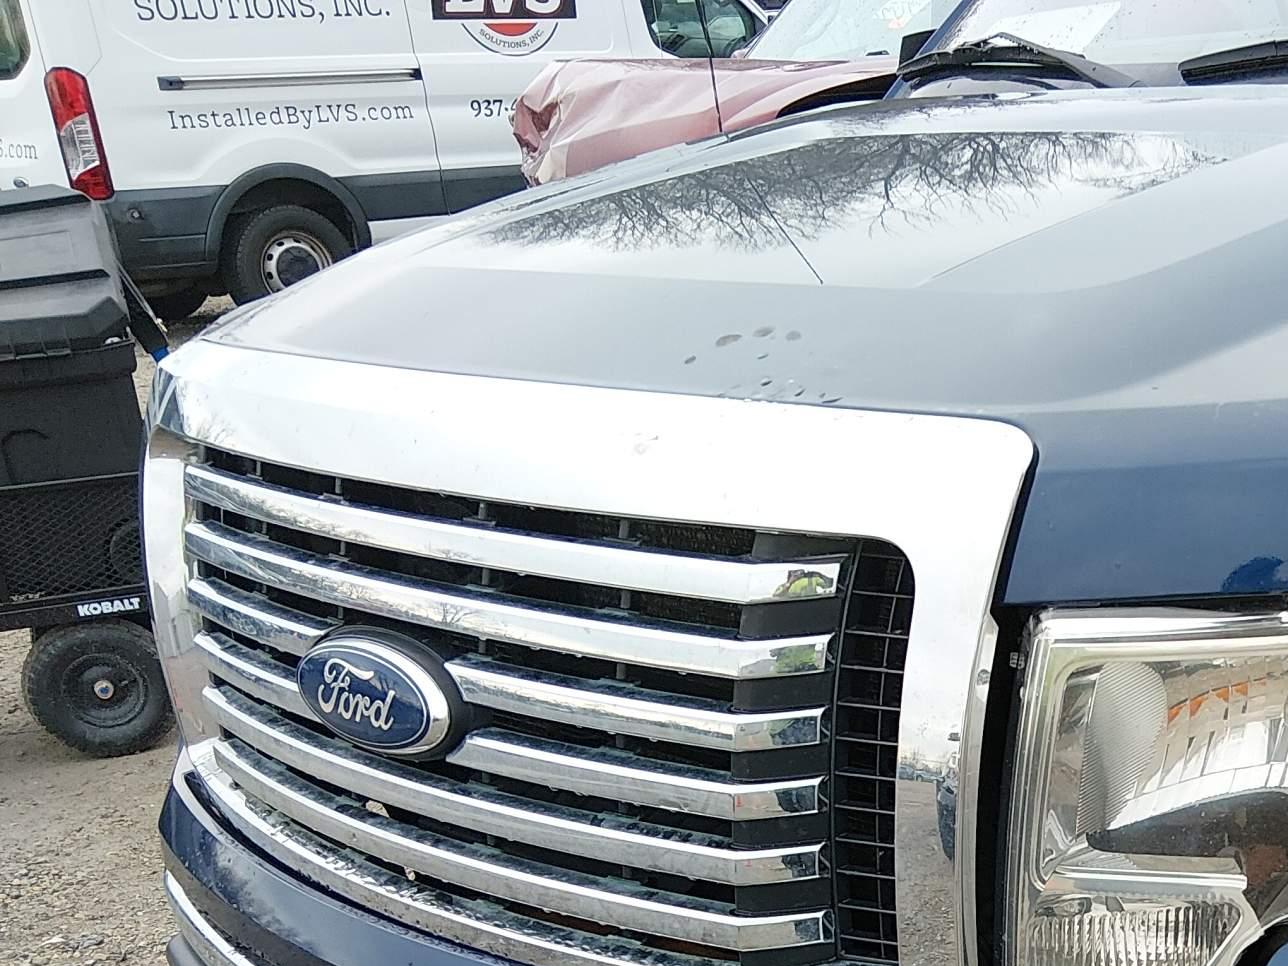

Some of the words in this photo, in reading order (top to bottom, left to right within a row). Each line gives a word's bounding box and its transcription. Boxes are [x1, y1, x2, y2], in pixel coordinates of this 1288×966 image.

[134, 0, 326, 23] SOLUTIONS,
[332, 0, 391, 17] INC.
[479, 28, 530, 49] SOLUTIONS,
[529, 29, 545, 45] INC.
[167, 103, 414, 130] InstalledByLVS.com
[77, 597, 141, 617] KOBALT
[317, 657, 396, 731] Ford
